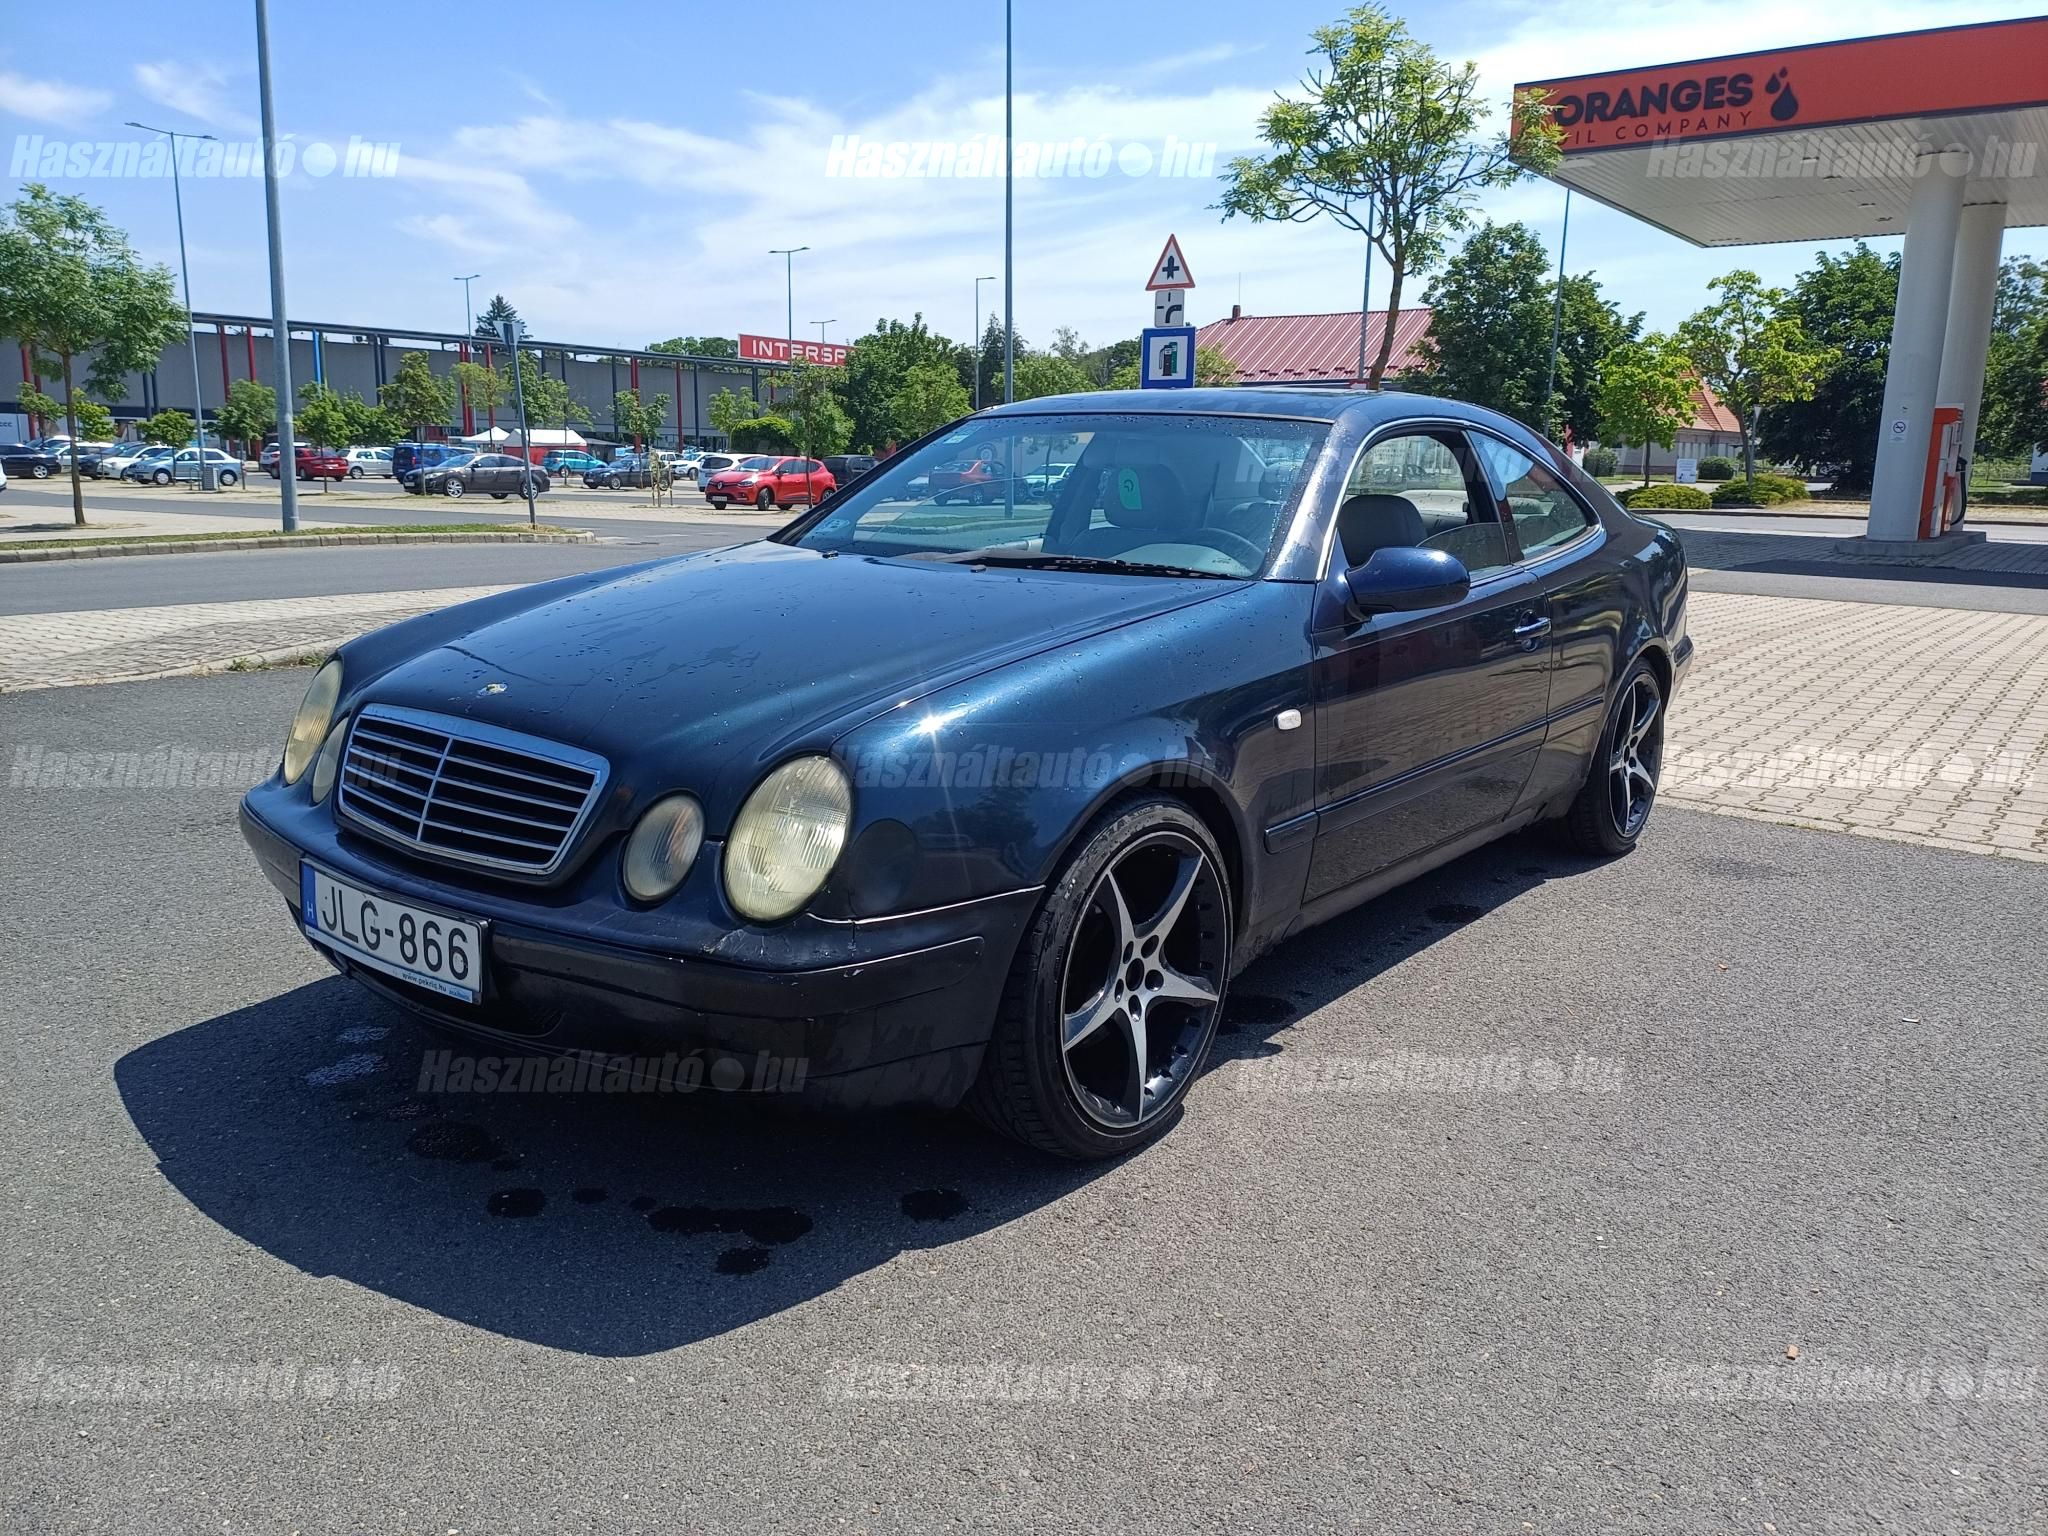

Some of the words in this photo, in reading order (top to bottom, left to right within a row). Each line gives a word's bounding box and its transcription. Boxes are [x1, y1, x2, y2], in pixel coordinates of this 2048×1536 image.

[1553, 73, 1753, 127] ORANGES
[1558, 129, 1596, 146] IL
[1616, 110, 1753, 140] COMPANY
[752, 339, 849, 363] INTERSP
[306, 902, 315, 919] H
[322, 886, 469, 980] JLG-866
